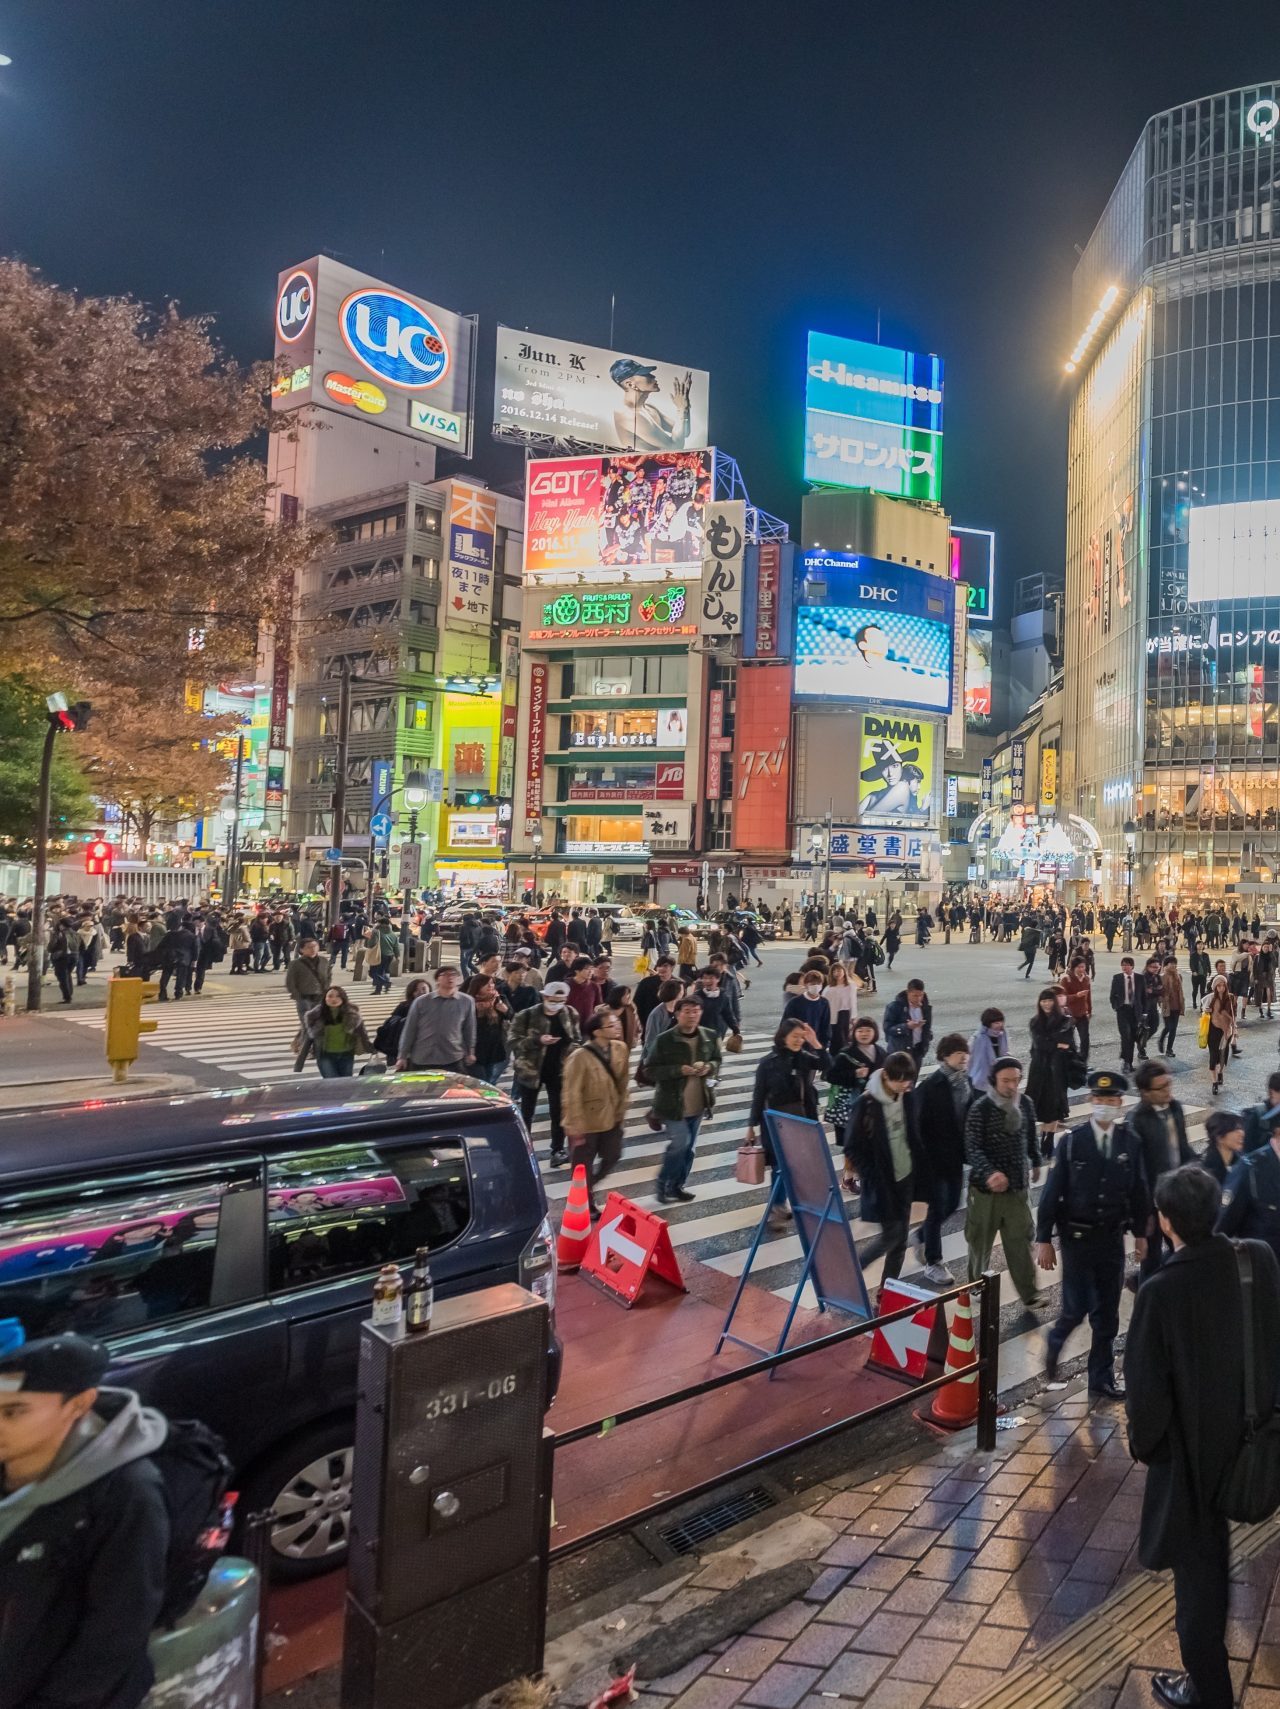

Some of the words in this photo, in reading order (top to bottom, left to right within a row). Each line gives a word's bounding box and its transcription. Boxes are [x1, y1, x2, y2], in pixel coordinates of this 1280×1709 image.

[281, 287, 310, 327] UC
[356, 303, 442, 372] UC
[568, 353, 587, 371] K
[557, 372, 586, 384] 2PM
[325, 379, 386, 408] MasterCard
[418, 411, 458, 434] VISA
[500, 404, 558, 423] 2016.12.14
[812, 432, 936, 477] サロンパス
[530, 469, 599, 497] GOT7
[702, 515, 742, 632] もんじゃ
[824, 559, 859, 569] Channel
[458, 582, 482, 596] まで
[859, 585, 898, 602] DHC
[966, 586, 986, 609] 21
[467, 600, 489, 614] 地下
[582, 603, 630, 625] 西村
[964, 696, 988, 711] 2/7
[574, 732, 654, 749] Euphoria
[864, 716, 921, 743] DMM
[863, 738, 903, 763] FX
[379, 768, 388, 795] MIZUNO
[658, 766, 684, 784] JTB
[1012, 744, 1024, 801] 洋服の青山
